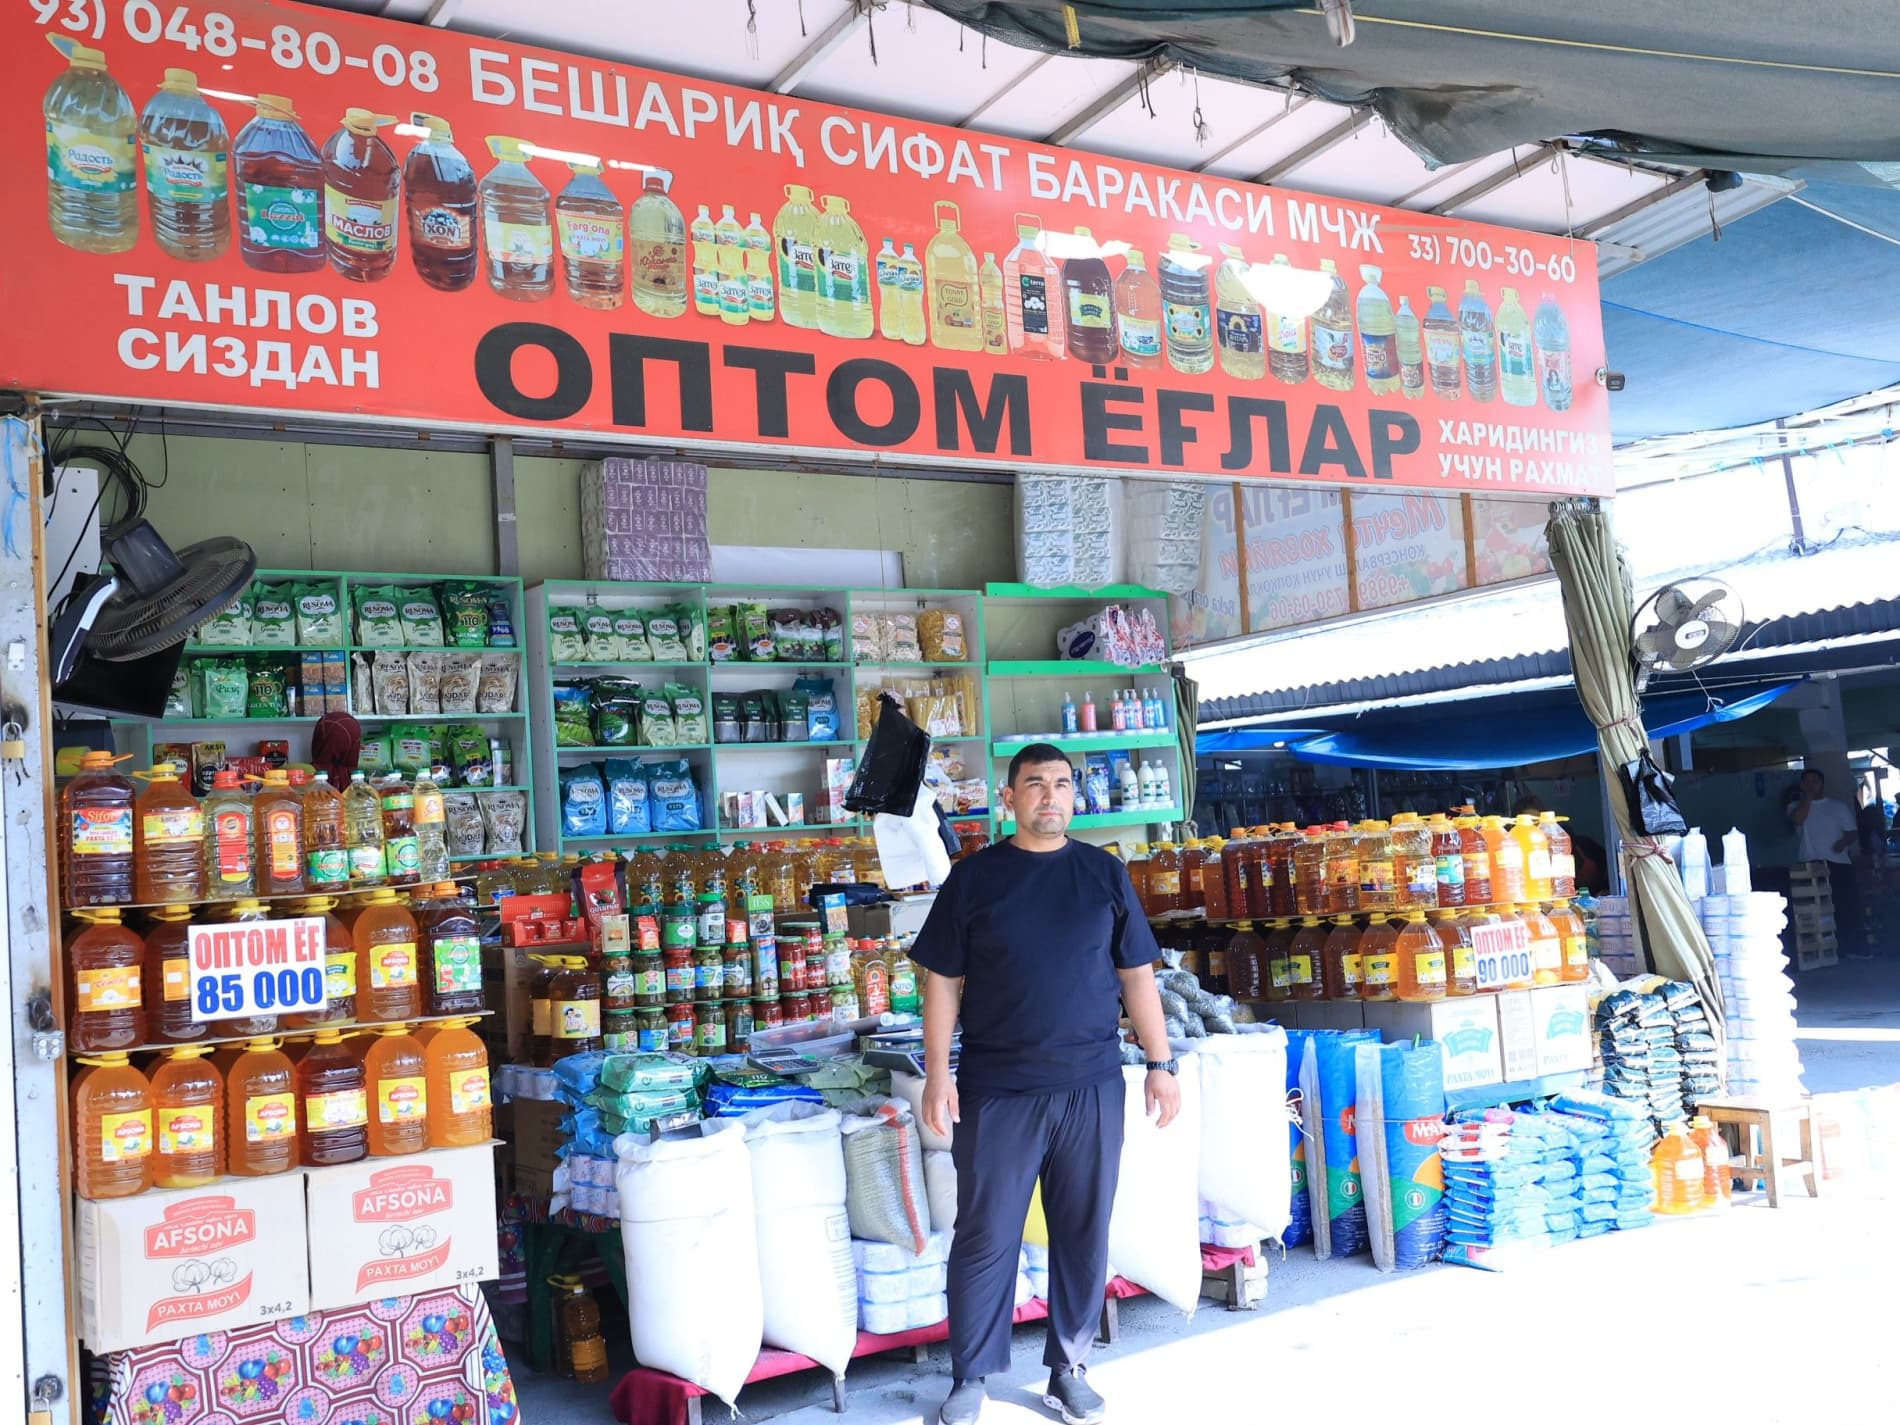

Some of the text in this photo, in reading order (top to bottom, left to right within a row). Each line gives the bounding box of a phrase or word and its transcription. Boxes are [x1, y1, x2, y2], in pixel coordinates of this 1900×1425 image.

[123, 0, 440, 93] 048-80-08
[469, 47, 1384, 254] БЕШАРИҚ СИФАТ БАРАКАСИ МЧЖ
[332, 215, 392, 240] МАСЛОВ
[1408, 234, 1576, 283] 33) 700-30-60
[113, 274, 379, 338] ТАНЛОВ
[117, 328, 380, 390] СИЗДАН
[474, 322, 1031, 456] ОПТОМ
[1438, 418, 1599, 455] ХАРИДИНГИЗ
[1438, 453, 1503, 481] УЧУН
[255, 686, 273, 697] 110
[195, 928, 288, 970] ОПТОМ
[1474, 927, 1513, 955] ОПТОМ
[1478, 952, 1529, 983] 90 000
[197, 967, 323, 1014] 85 000
[361, 1186, 446, 1215] AFSONA
[153, 1218, 248, 1250] AFSONA
[366, 1263, 407, 1277] PAXTA
[157, 1300, 204, 1318] PAXTA
[260, 1301, 293, 1316] 3x4,2
